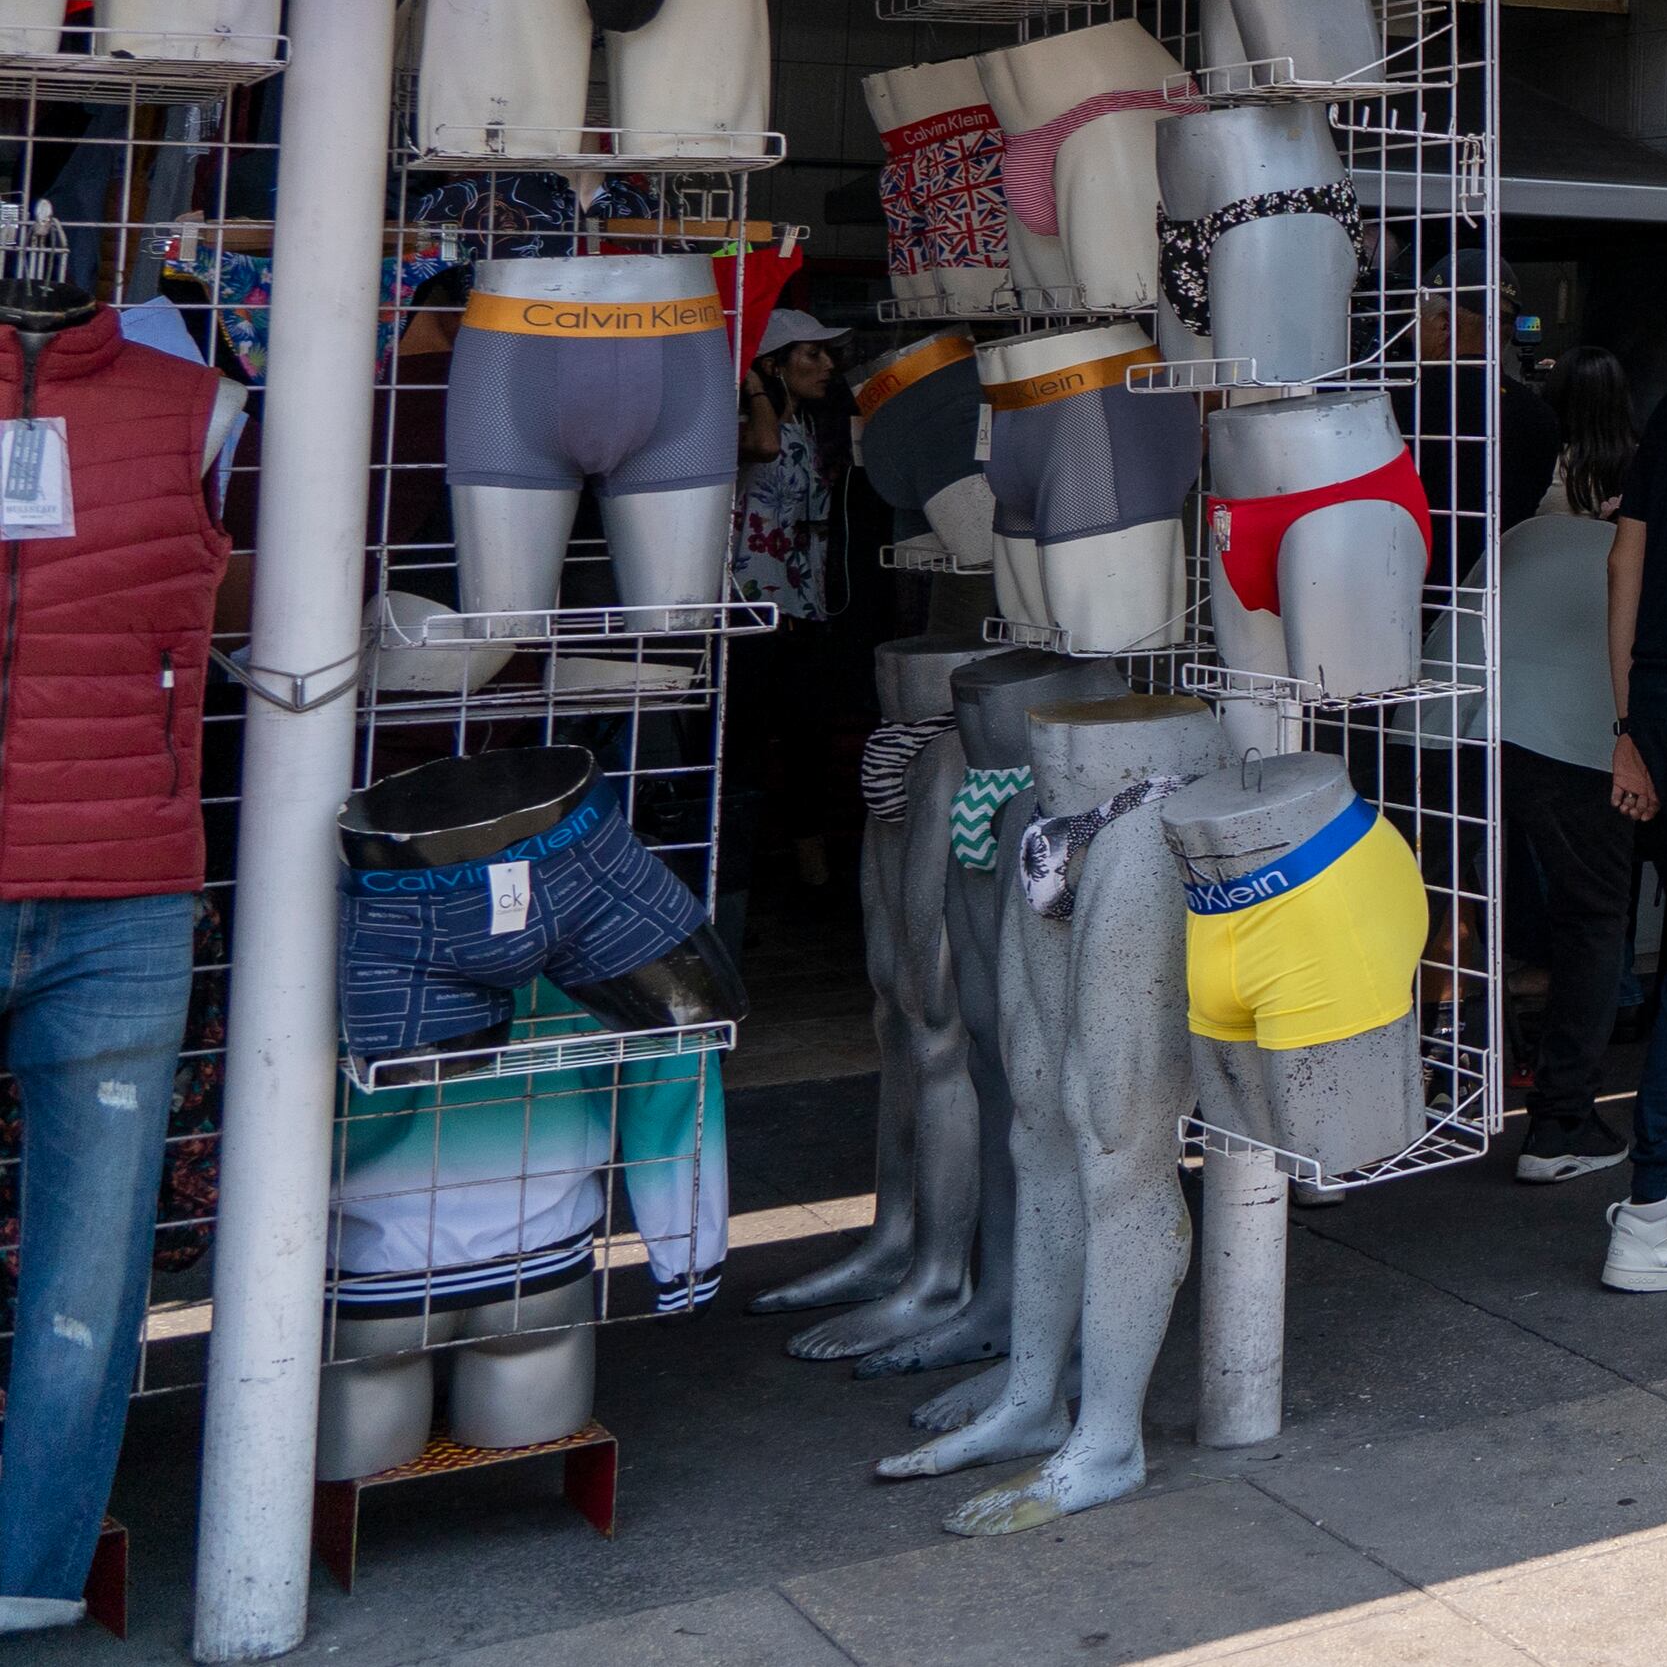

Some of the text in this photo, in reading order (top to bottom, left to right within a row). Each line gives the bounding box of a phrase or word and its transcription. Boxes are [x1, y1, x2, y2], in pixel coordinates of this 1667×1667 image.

[902, 110, 990, 145] Calvin Klein
[522, 303, 719, 330] Calvin Klein
[1014, 371, 1085, 401] Klein
[505, 806, 600, 863] Klein
[498, 884, 524, 910] ck
[1198, 870, 1289, 911] Klein
